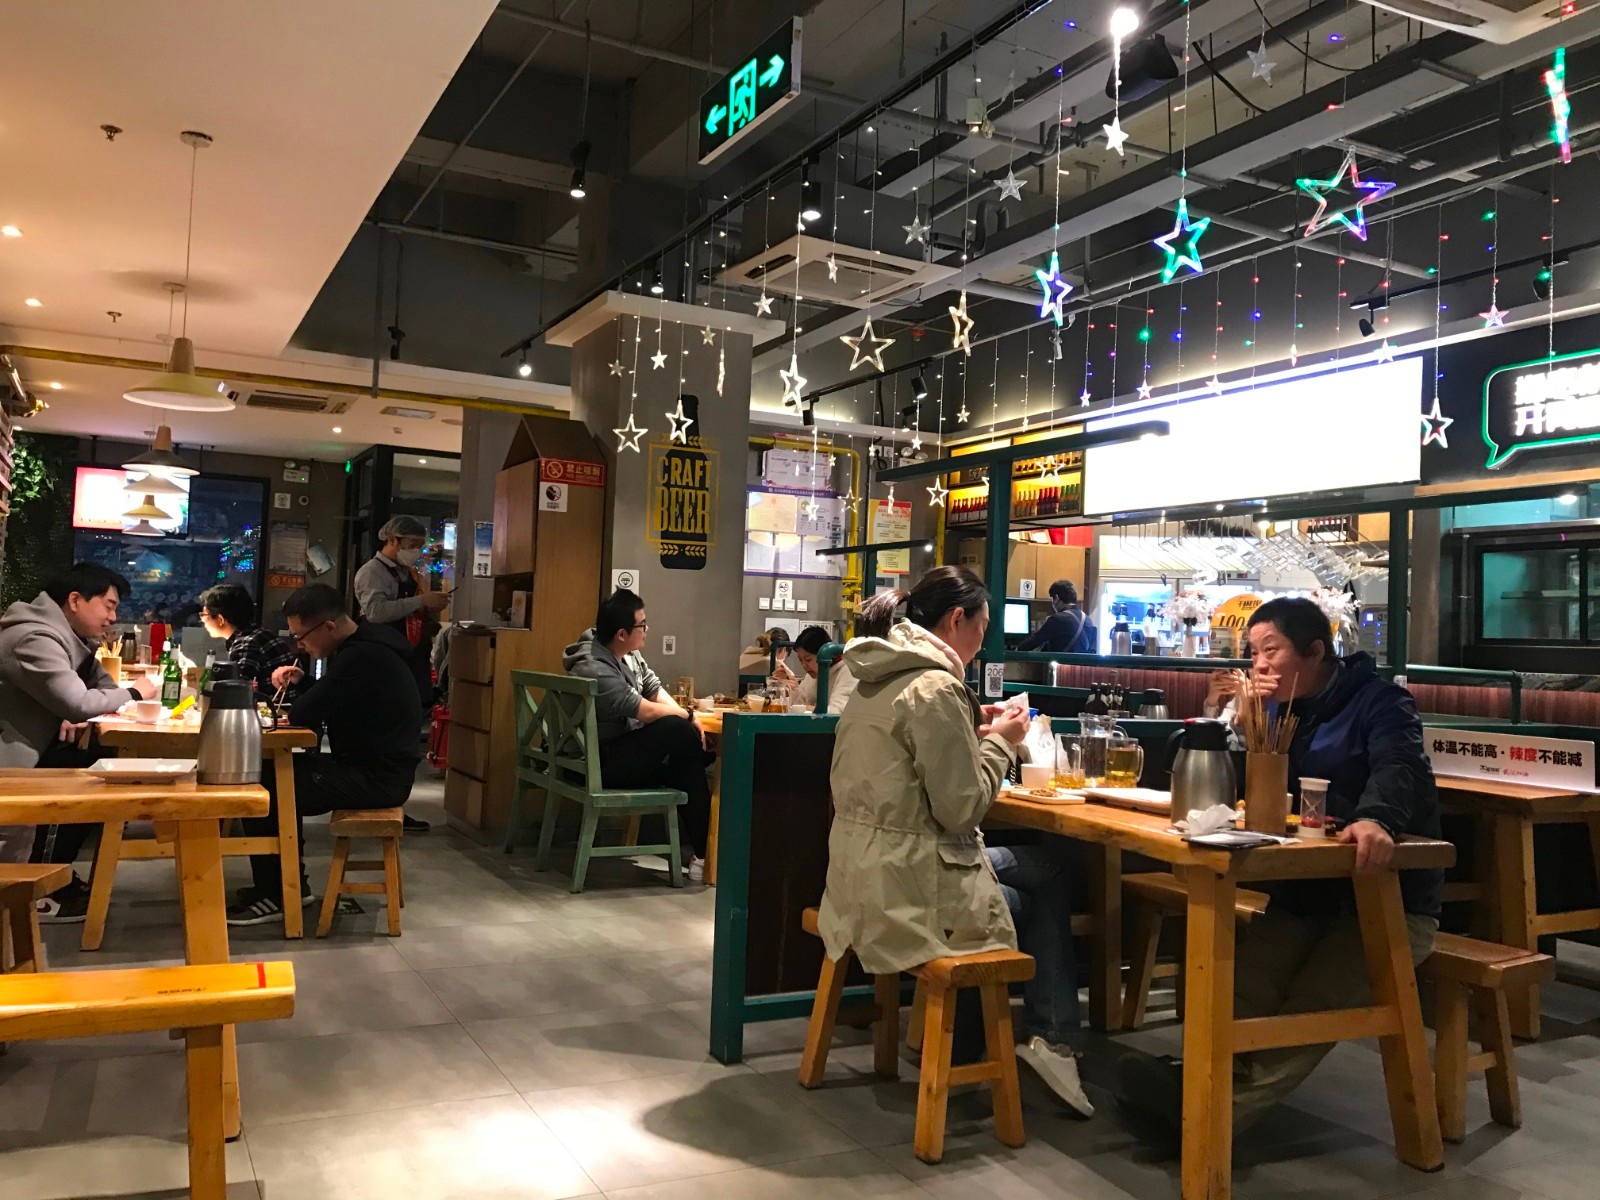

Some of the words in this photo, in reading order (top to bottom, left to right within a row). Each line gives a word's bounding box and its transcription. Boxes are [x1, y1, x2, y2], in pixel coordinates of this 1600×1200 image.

[656, 455, 713, 488] CRAFT
[653, 486, 712, 535] BEER
[988, 668, 1004, 676] 206
[1433, 739, 1583, 767] 体温不能高·辣度不能减
